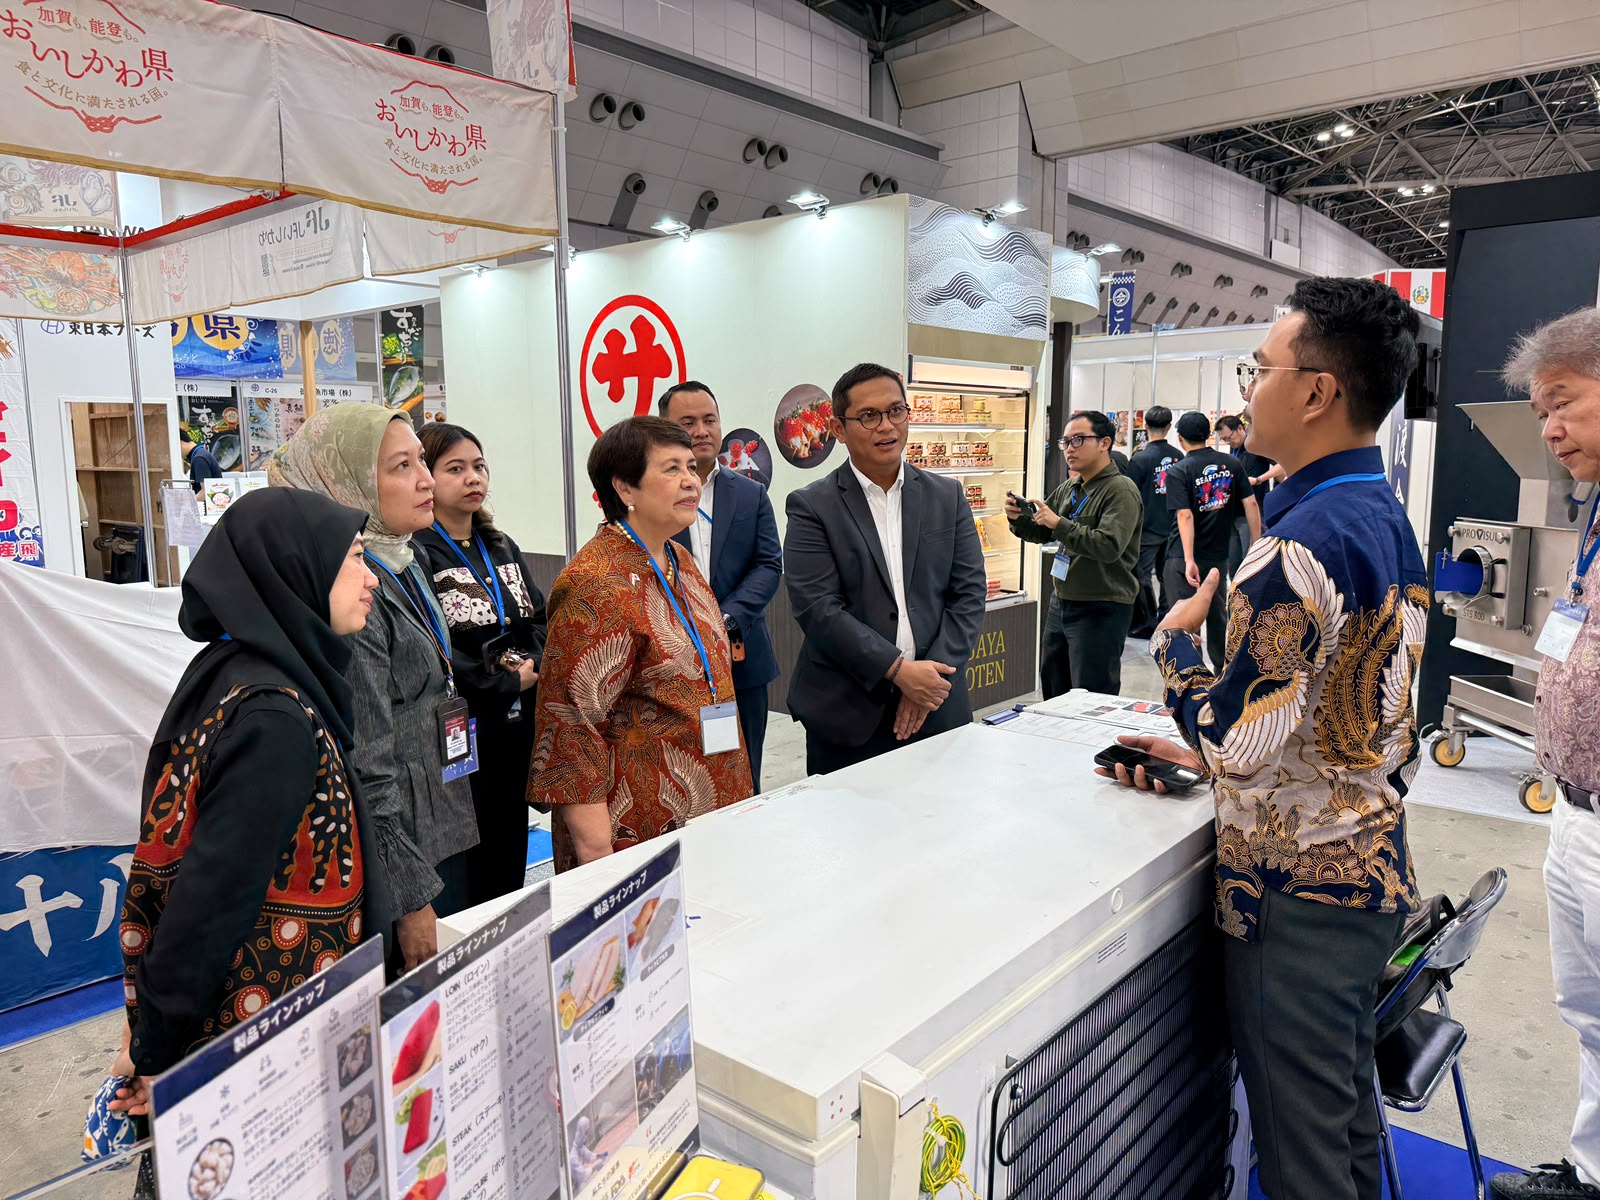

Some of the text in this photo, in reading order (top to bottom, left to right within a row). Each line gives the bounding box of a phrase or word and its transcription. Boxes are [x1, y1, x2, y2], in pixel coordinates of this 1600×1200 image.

[38, 6, 139, 43] 加賀も、能登も。
[0, 9, 174, 88] おいしかわ県
[14, 60, 168, 110] 食と文化に満たされる国。
[399, 95, 465, 121] 加賀も、能登も。
[375, 98, 487, 157] おいしかわ県
[383, 137, 483, 175] 食と文化に満たされる国。
[68, 322, 157, 339] 東日本フズ
[592, 314, 673, 418] サ
[175, 384, 199, 393] （株）
[1195, 469, 1231, 486] SEAFOOD
[1462, 529, 1498, 541] PROVISU
[1463, 609, 1485, 620] STS 800
[593, 869, 648, 920] 製品ラインナップ
[436, 916, 509, 976] 製品ラインナップ
[233, 979, 327, 1053] 製品ラインナップ
[449, 1057, 467, 1075] SAKU
[452, 1123, 473, 1147] STEAK
